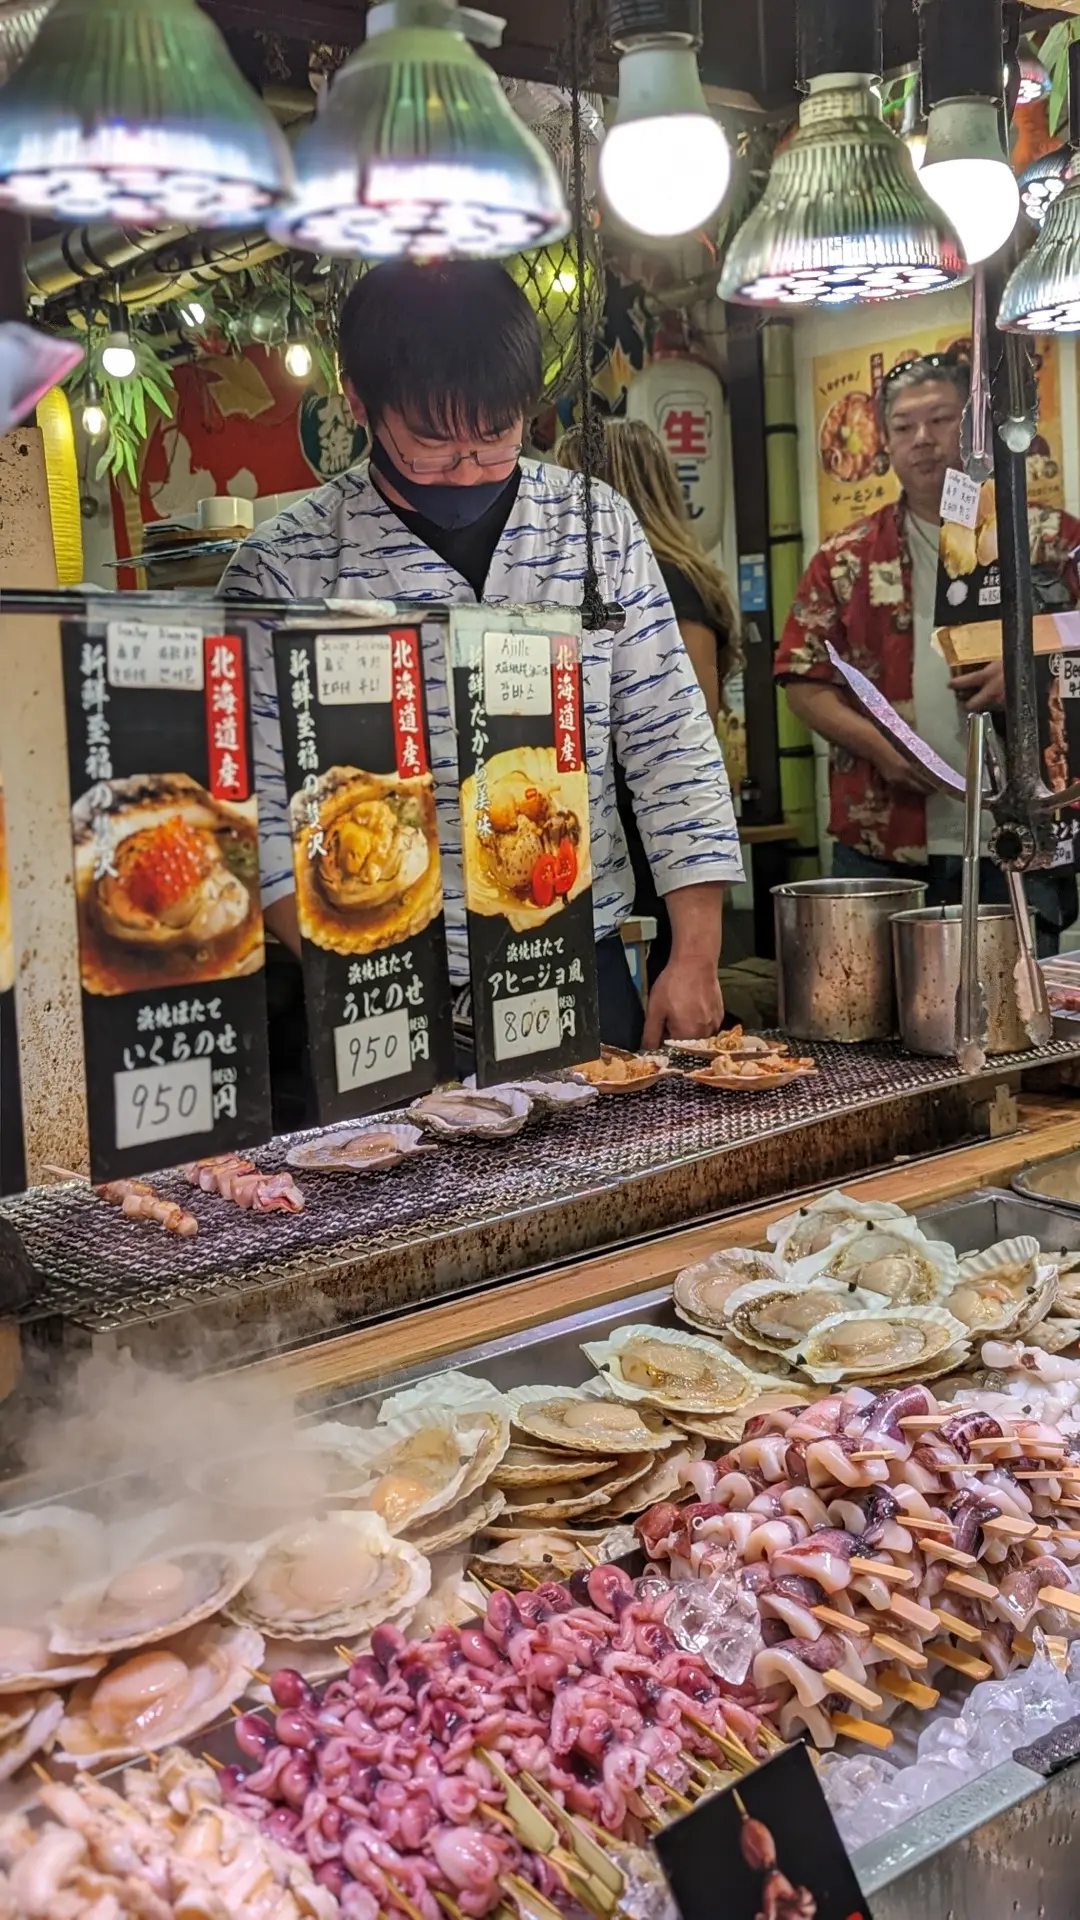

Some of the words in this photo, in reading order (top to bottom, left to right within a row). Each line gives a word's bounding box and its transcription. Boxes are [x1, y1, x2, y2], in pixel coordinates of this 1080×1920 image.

[393, 639, 421, 767] 北海道産
[500, 681, 535, 701] 감바스
[556, 644, 577, 763] 北海道産
[210, 645, 241, 789] 北海道産
[347, 951, 414, 986] 浜焼ほたて
[505, 937, 565, 963] 浜焼ほたて
[342, 974, 425, 1024] うにのせ
[488, 957, 585, 998] アヒージョ風
[136, 997, 222, 1032] 浜焼ほたて
[504, 1009, 550, 1042] 800
[560, 1008, 576, 1040] 円
[123, 1023, 238, 1070] いくらのせ
[349, 1034, 398, 1077] 950
[410, 1030, 430, 1062] 円
[132, 1083, 198, 1130] 950
[213, 1084, 237, 1120] 円
